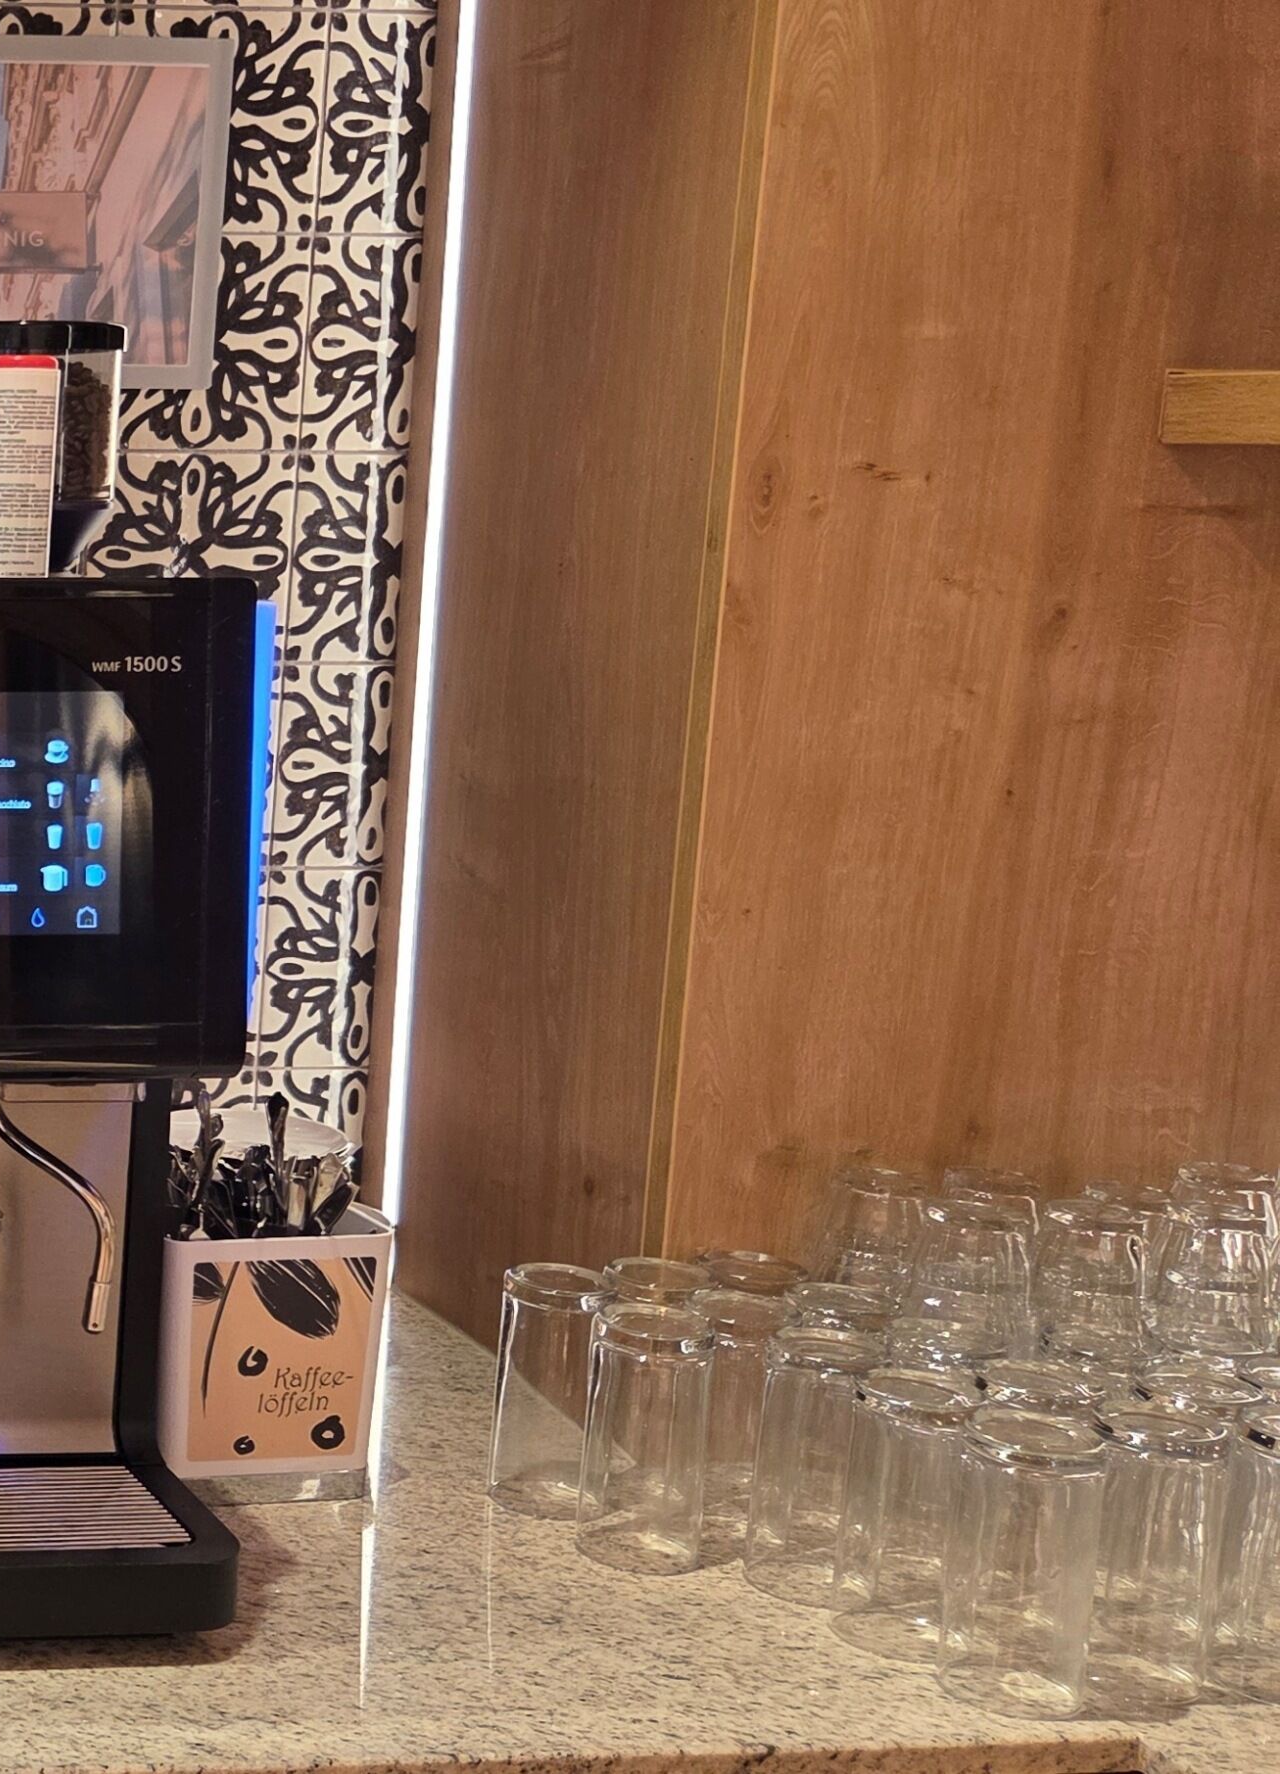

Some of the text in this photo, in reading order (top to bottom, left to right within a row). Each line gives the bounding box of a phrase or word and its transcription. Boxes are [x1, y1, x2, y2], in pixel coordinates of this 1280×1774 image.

[91, 656, 183, 673] WMF 1500 S
[273, 1366, 354, 1393] Kaffee-
[257, 1391, 329, 1418] löffeln
